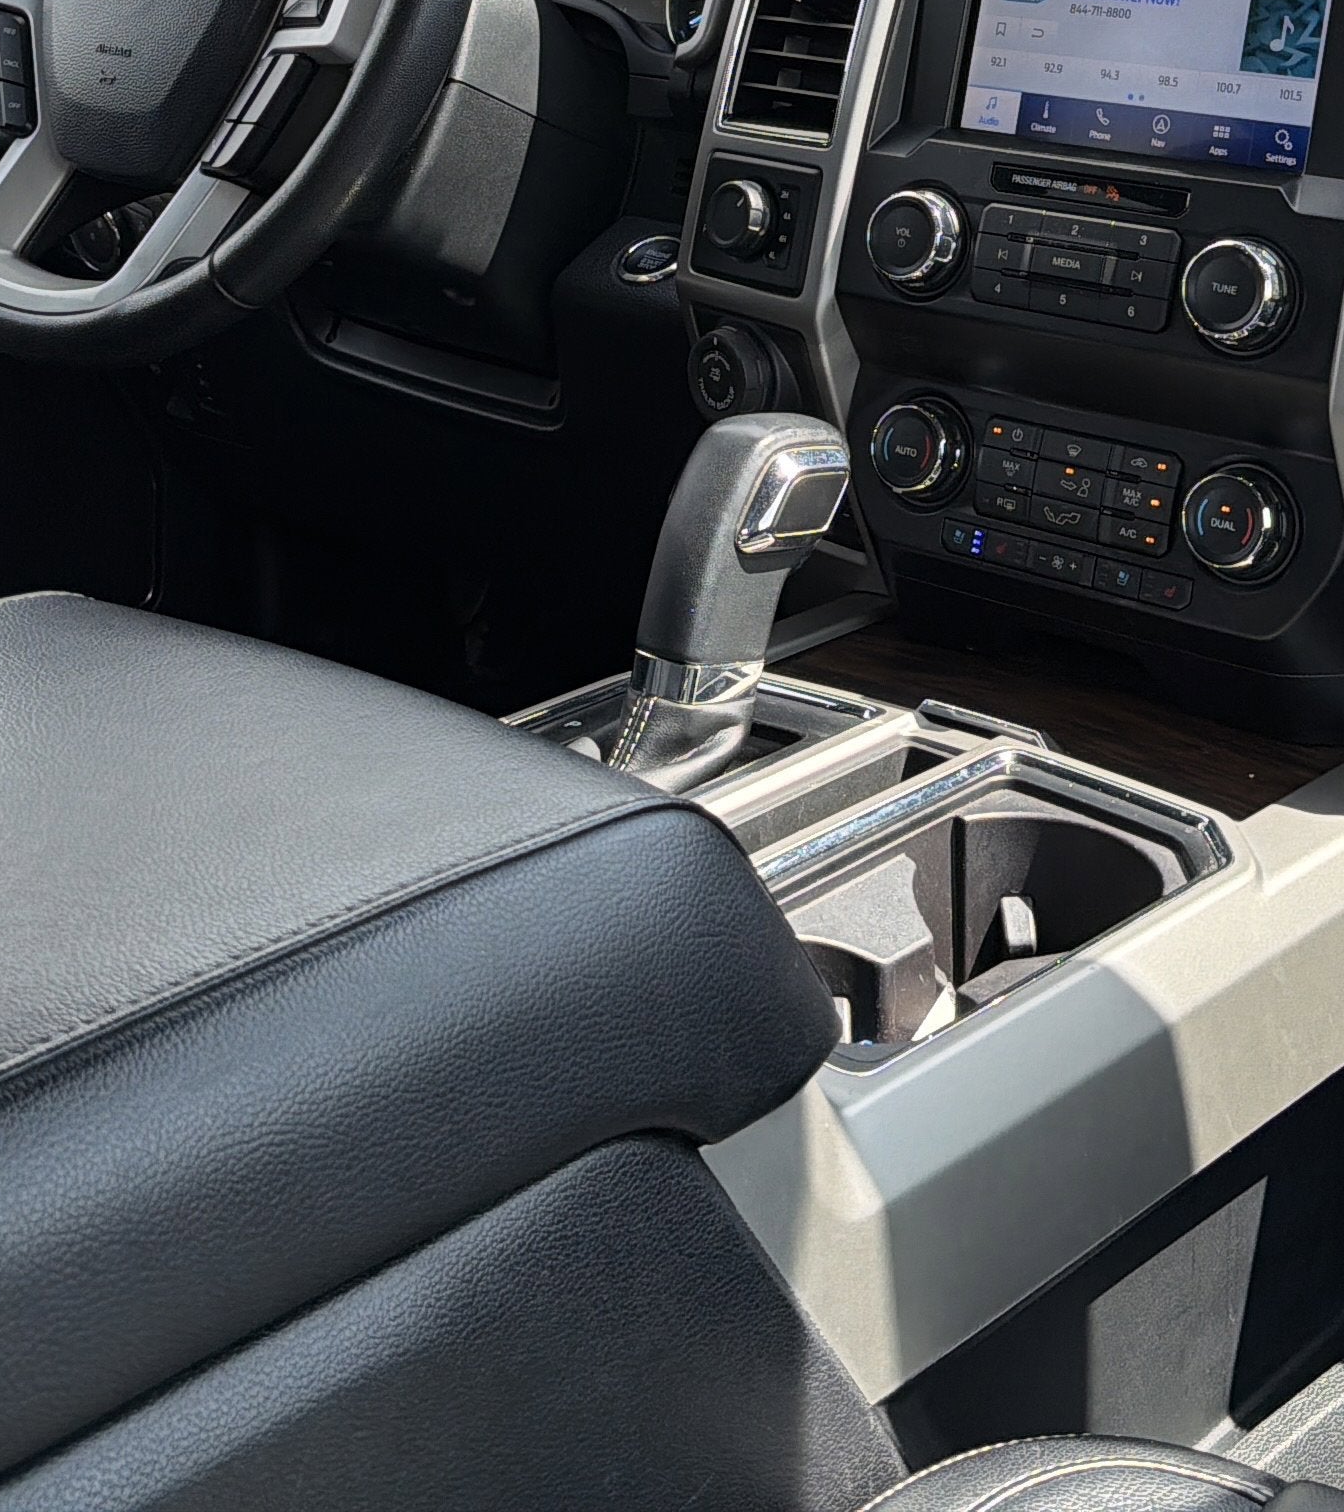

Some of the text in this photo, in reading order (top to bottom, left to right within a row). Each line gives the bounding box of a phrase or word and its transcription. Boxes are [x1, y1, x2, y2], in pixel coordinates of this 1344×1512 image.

[1070, 3, 1132, 19] 844-711-8800
[990, 56, 1007, 68] 92.1
[1044, 62, 1063, 74] 92.9
[1100, 69, 1120, 81] 94.3
[1158, 75, 1178, 87] 98.5
[1216, 81, 1242, 95] 100.7
[1279, 88, 1303, 102] 101.5
[978, 115, 1000, 127] Audio
[1030, 122, 1057, 134] Climate
[1088, 129, 1112, 142] Phone
[1150, 137, 1166, 149] Nav
[1208, 145, 1229, 157] Apps
[1265, 152, 1297, 167] Settings
[1011, 174, 1052, 188] PASSENGER
[1051, 179, 1078, 192] AIRBAG
[1007, 214, 1014, 226] 1
[894, 226, 912, 239] VOL
[1071, 224, 1079, 236] 2
[1139, 234, 1148, 246] 3
[1052, 256, 1081, 271] MEDIA
[994, 282, 1001, 293] 4
[1211, 281, 1238, 296] TUNE
[1059, 294, 1067, 305] 5
[1127, 305, 1135, 317] 6
[895, 445, 918, 458] AUTO
[1002, 459, 1021, 473] MAX
[1122, 487, 1142, 501] MAX
[1123, 495, 1140, 508] A/C
[1210, 517, 1236, 533] DUAL
[1119, 526, 1138, 540] A/C
